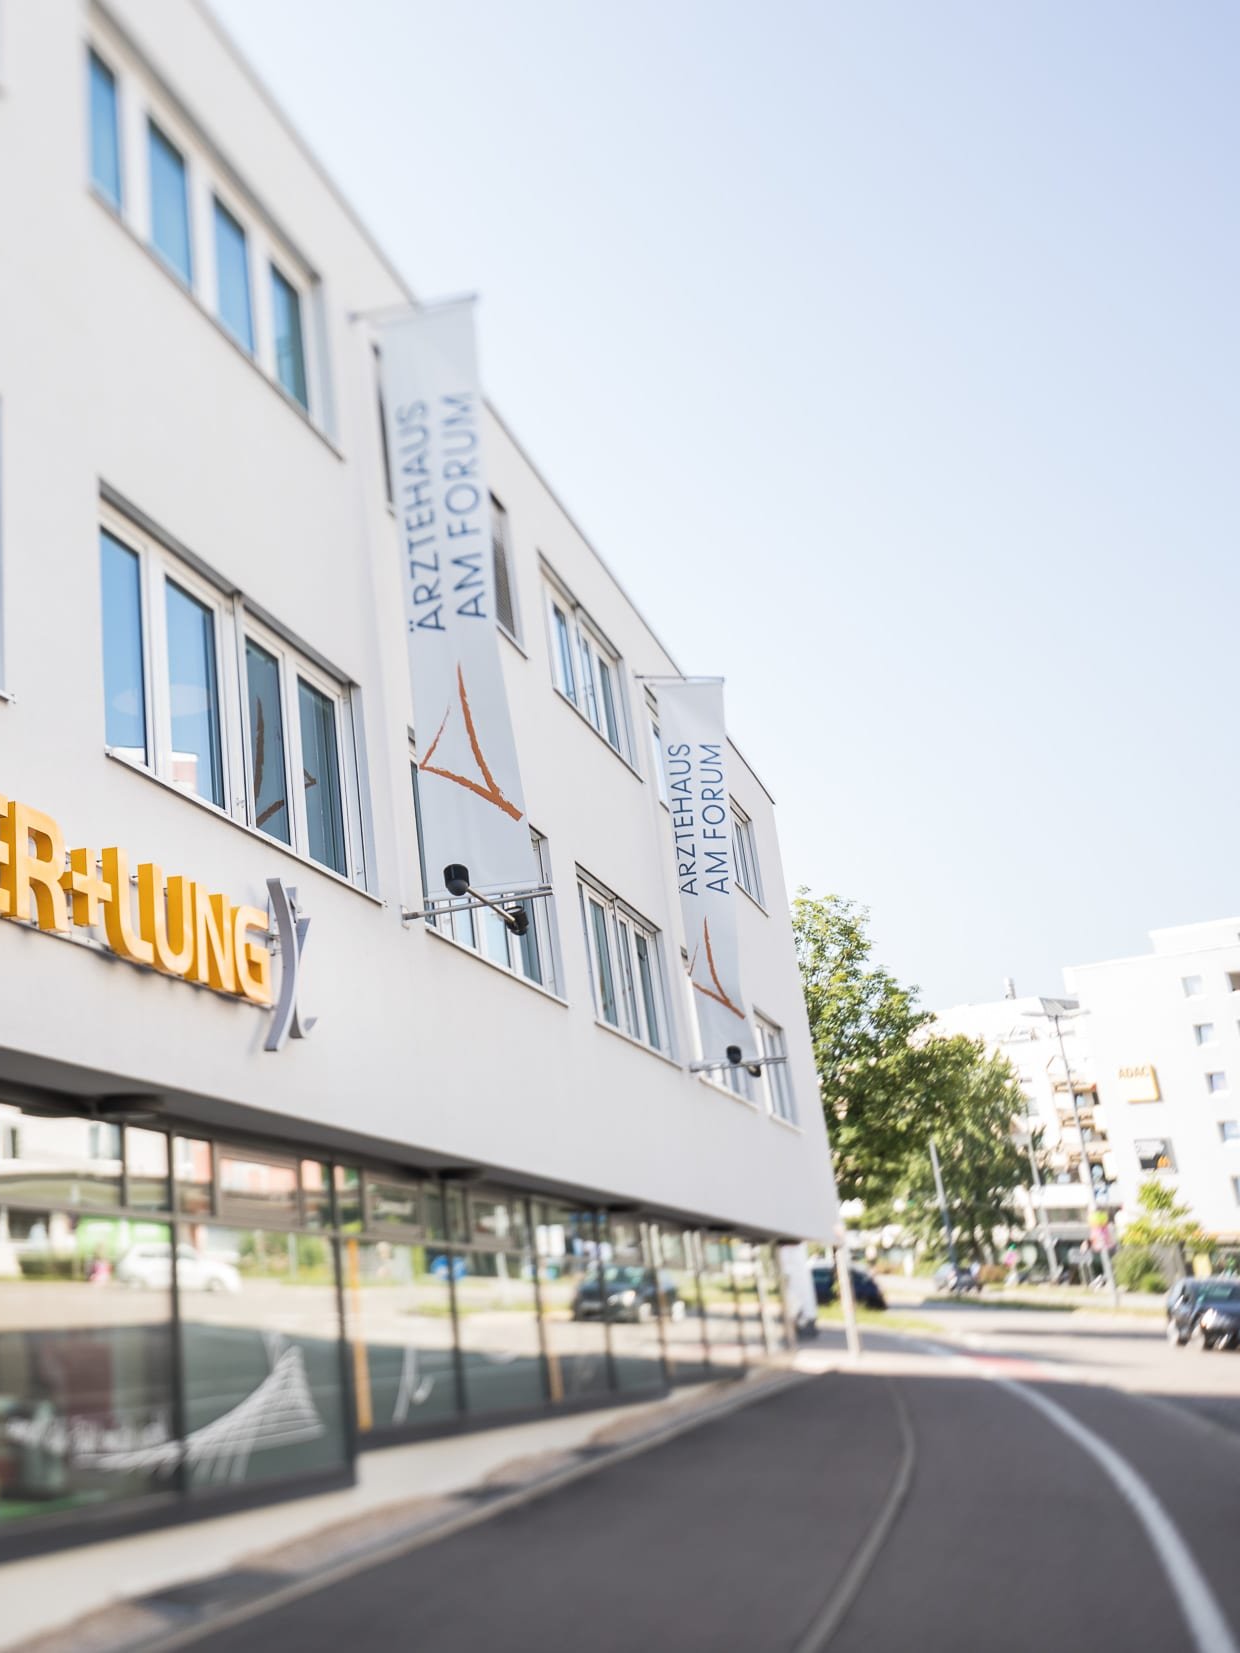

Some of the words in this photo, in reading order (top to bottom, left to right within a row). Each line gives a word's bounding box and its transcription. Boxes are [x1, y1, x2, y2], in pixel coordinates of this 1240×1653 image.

[395, 400, 447, 633] ÄRZTEHAUS
[442, 391, 484, 540] FORUM
[452, 551, 488, 620] AM
[667, 743, 699, 896] ÄRZTEHAUS
[699, 744, 727, 839] FORUM
[703, 851, 730, 895] AM
